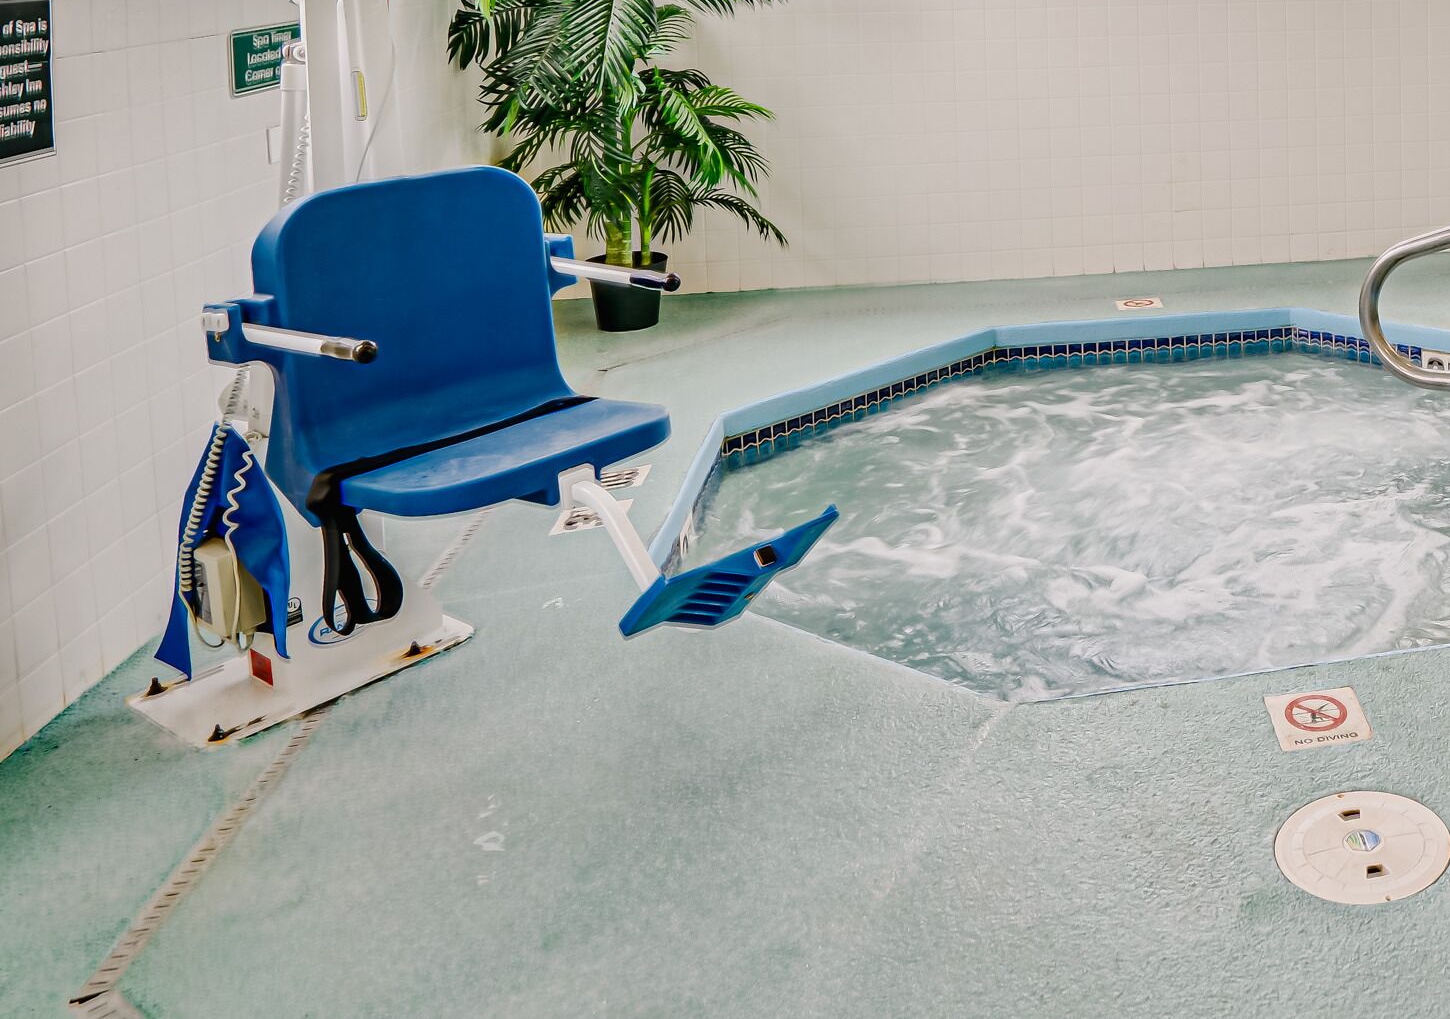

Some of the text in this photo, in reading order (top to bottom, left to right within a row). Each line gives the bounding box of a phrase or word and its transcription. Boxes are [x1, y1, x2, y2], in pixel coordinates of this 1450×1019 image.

[2, 17, 48, 38] of Spa is
[253, 35, 269, 49] Spa
[247, 46, 281, 66] Located
[245, 67, 274, 83] Corner
[25, 78, 43, 93] Inn
[33, 98, 48, 112] no
[1294, 731, 1359, 746] NO DIVING
